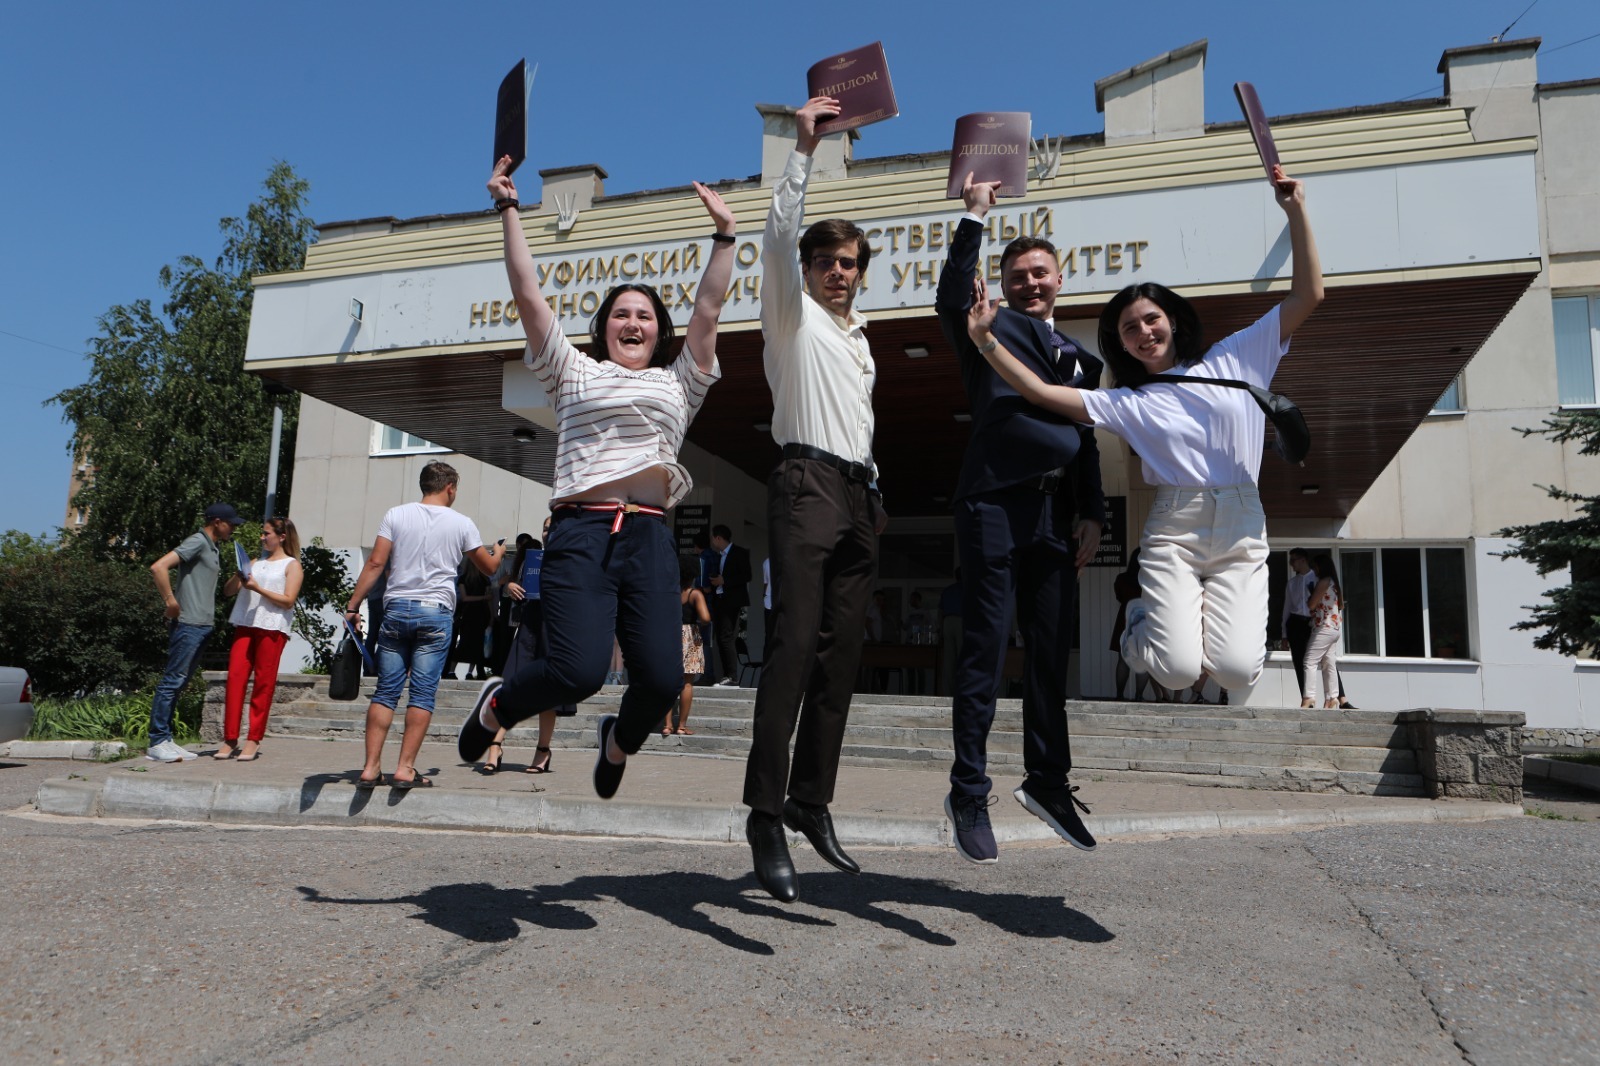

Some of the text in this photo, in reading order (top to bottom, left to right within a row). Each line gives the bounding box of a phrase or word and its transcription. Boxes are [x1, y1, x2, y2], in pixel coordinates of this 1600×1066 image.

[817, 71, 879, 97] ДИПЛОМ
[958, 144, 1020, 158] ДИПЛОМ
[538, 242, 702, 286] УФИМСКИЙ
